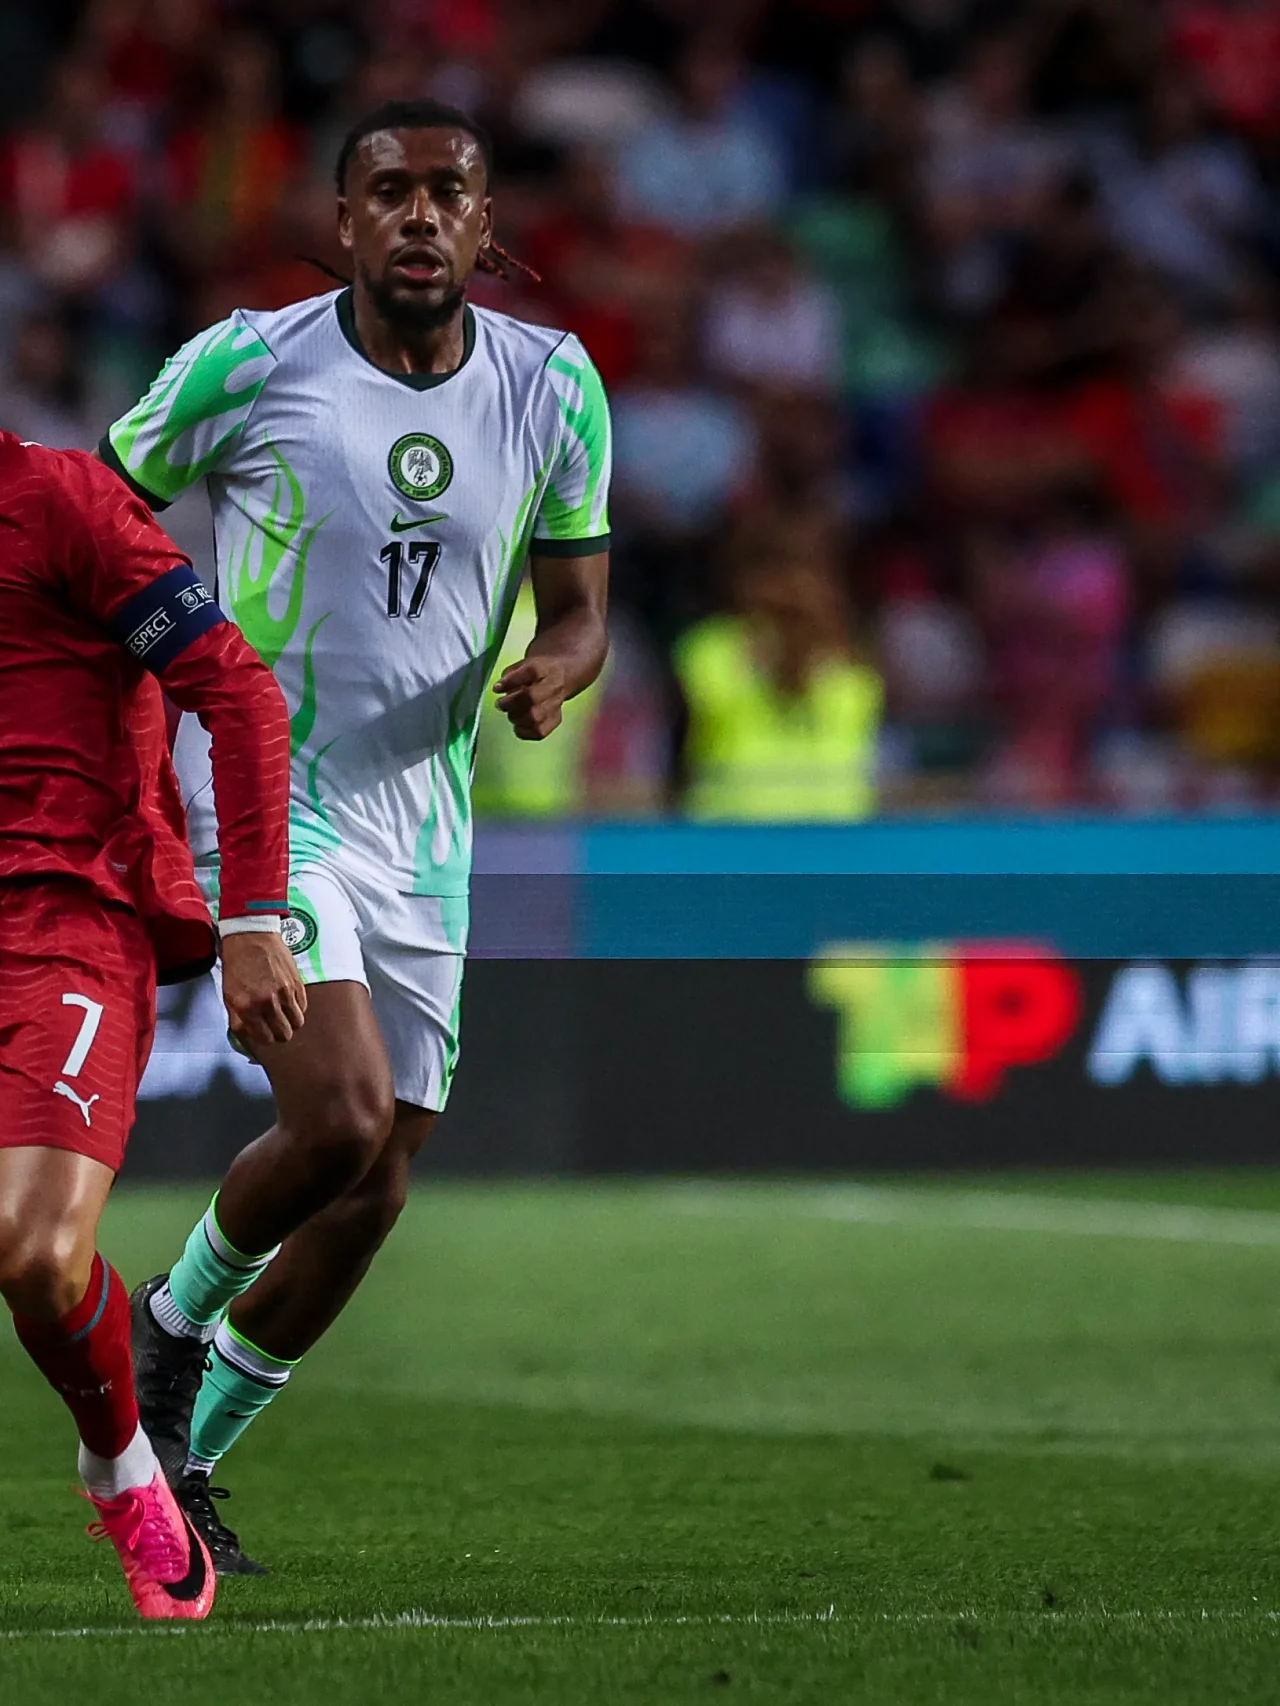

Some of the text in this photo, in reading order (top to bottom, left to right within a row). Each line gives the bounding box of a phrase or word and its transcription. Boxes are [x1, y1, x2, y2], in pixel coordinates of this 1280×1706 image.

[380, 542, 442, 619] 17
[128, 610, 172, 656] ESPECT
[61, 992, 104, 1078] 7
